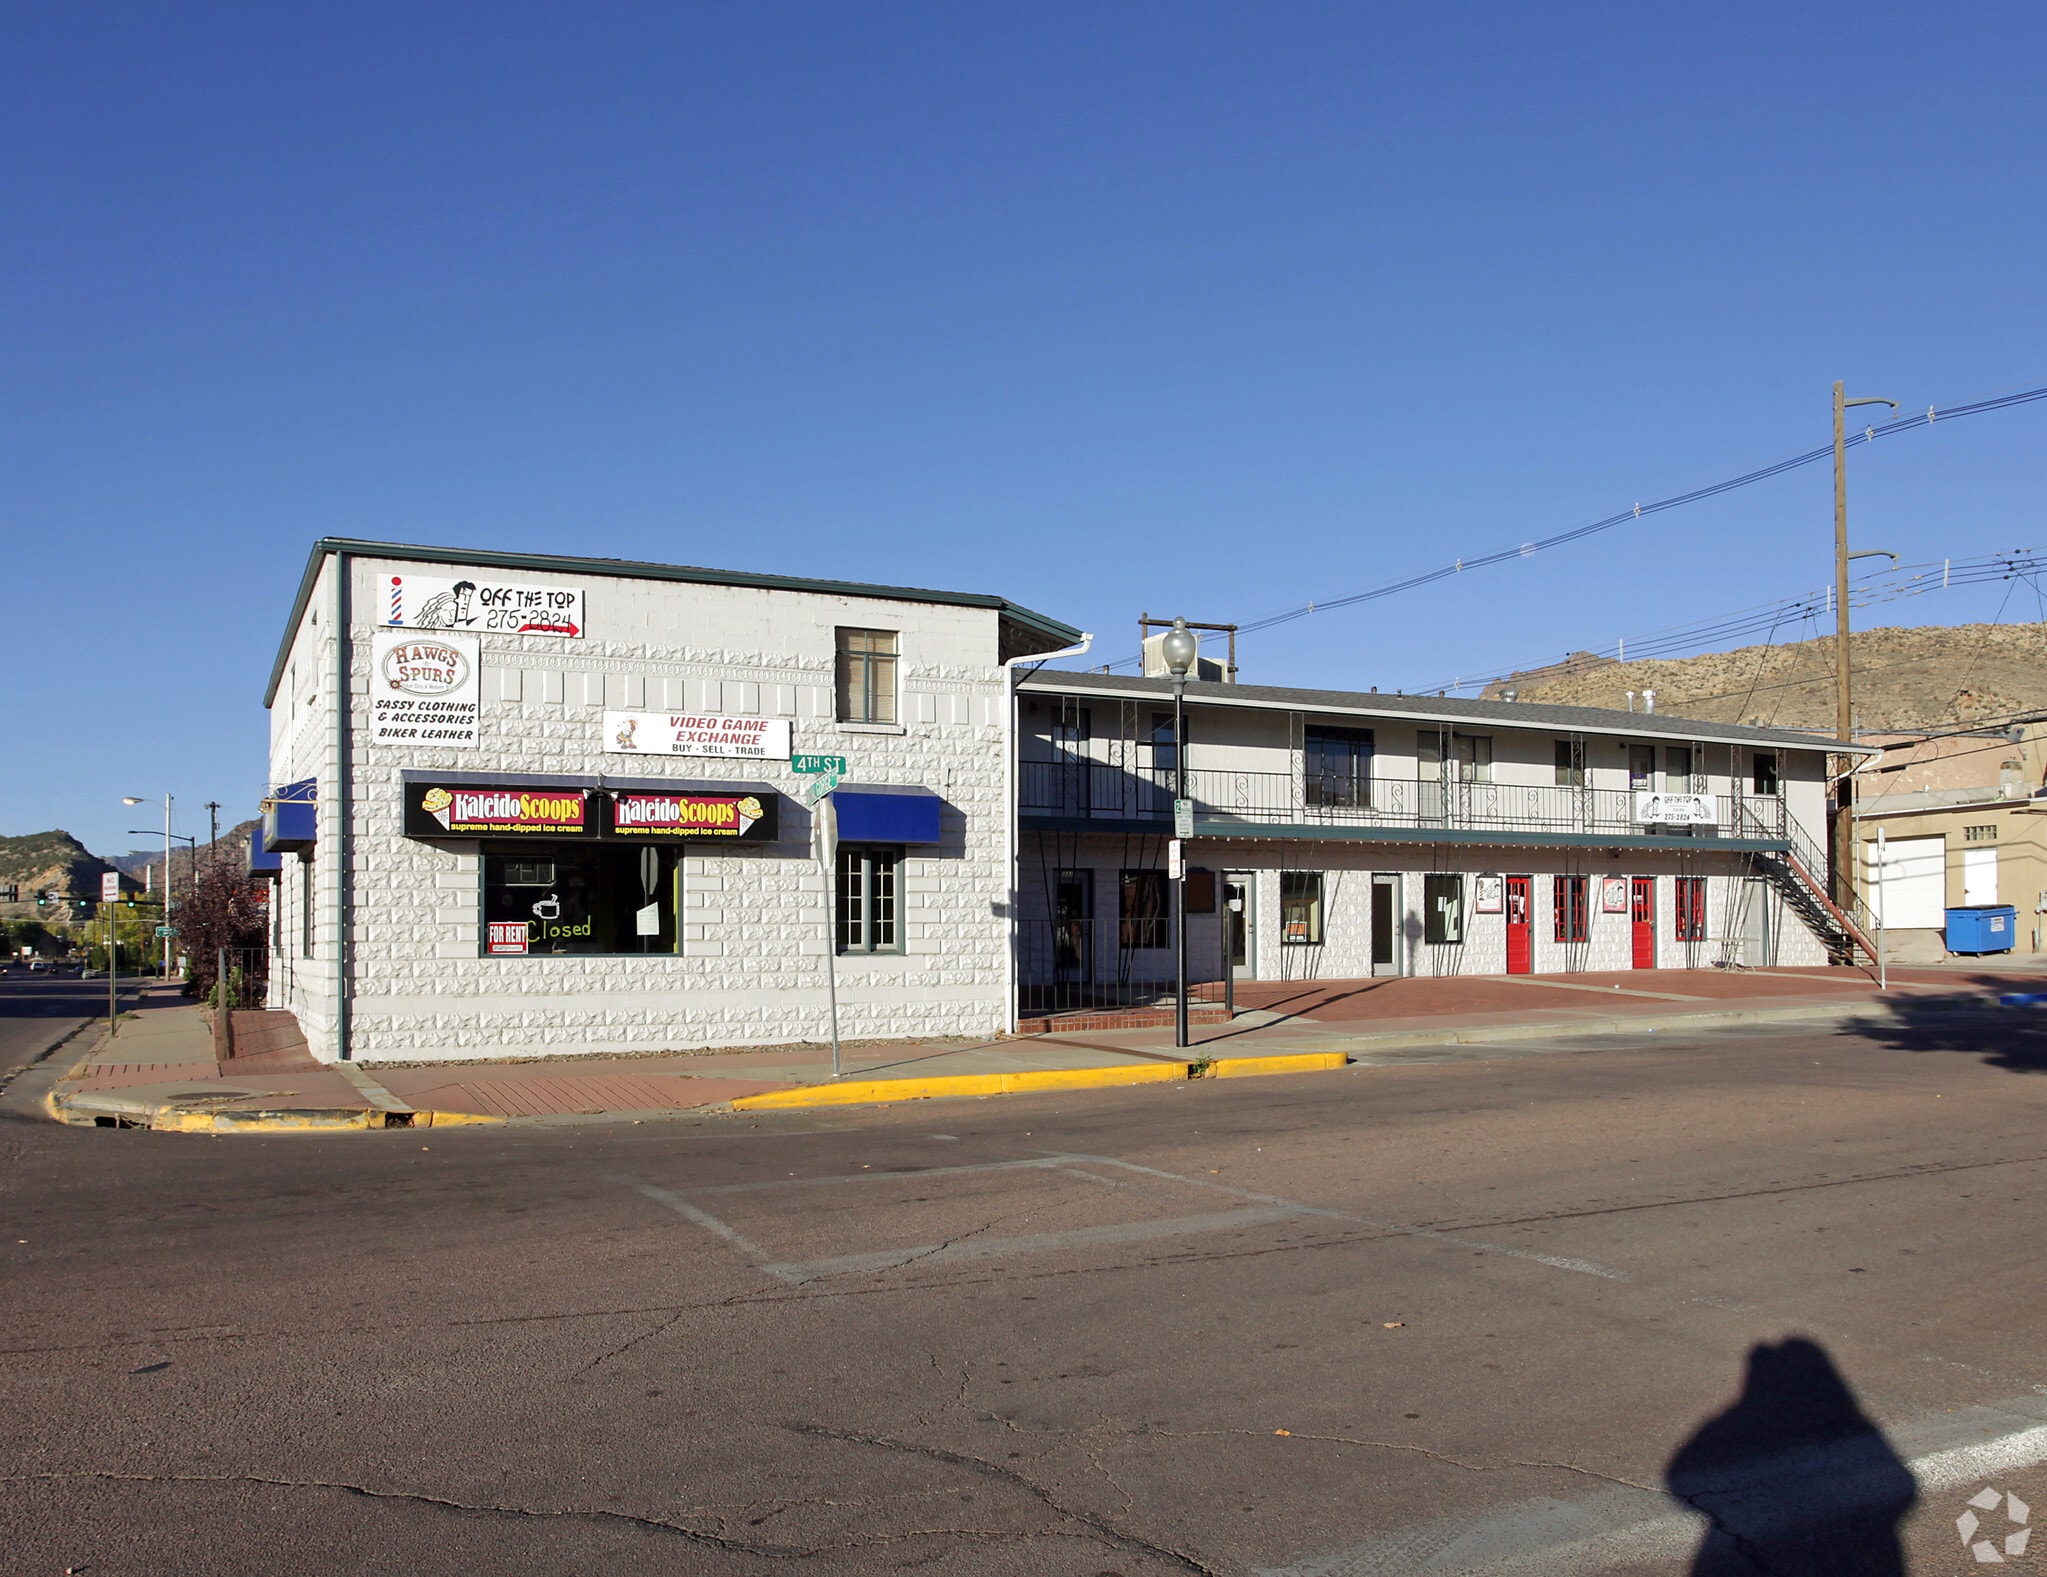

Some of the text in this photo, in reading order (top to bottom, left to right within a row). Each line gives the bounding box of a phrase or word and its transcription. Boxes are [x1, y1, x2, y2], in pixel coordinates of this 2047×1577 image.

[480, 587, 575, 609] OFF THE TOP
[487, 609, 571, 634] 275-2824
[393, 646, 459, 667] HAWGS
[399, 666, 455, 684] SPURS
[375, 700, 476, 712] SASSY CLOTHING
[378, 712, 475, 725] & ACCESSORIES
[670, 716, 769, 732] VIDEO GAME
[378, 728, 474, 740] BIKER LEATHER
[675, 731, 761, 745] EXCHANGE
[672, 744, 692, 753] BUY
[702, 745, 725, 754] SELL
[735, 746, 766, 756] TRADE
[797, 757, 820, 772] 4TH
[823, 757, 841, 773] ST
[455, 793, 580, 822] KaleidoScoops
[619, 798, 735, 826] KaleidoScoops
[451, 823, 583, 833] supreme hand-dipped ice cream
[615, 827, 650, 836] supreme
[651, 827, 700, 836] hand-dipped
[713, 828, 738, 836] cream
[490, 926, 525, 943] FOR RENT
[526, 915, 591, 943] Closed
